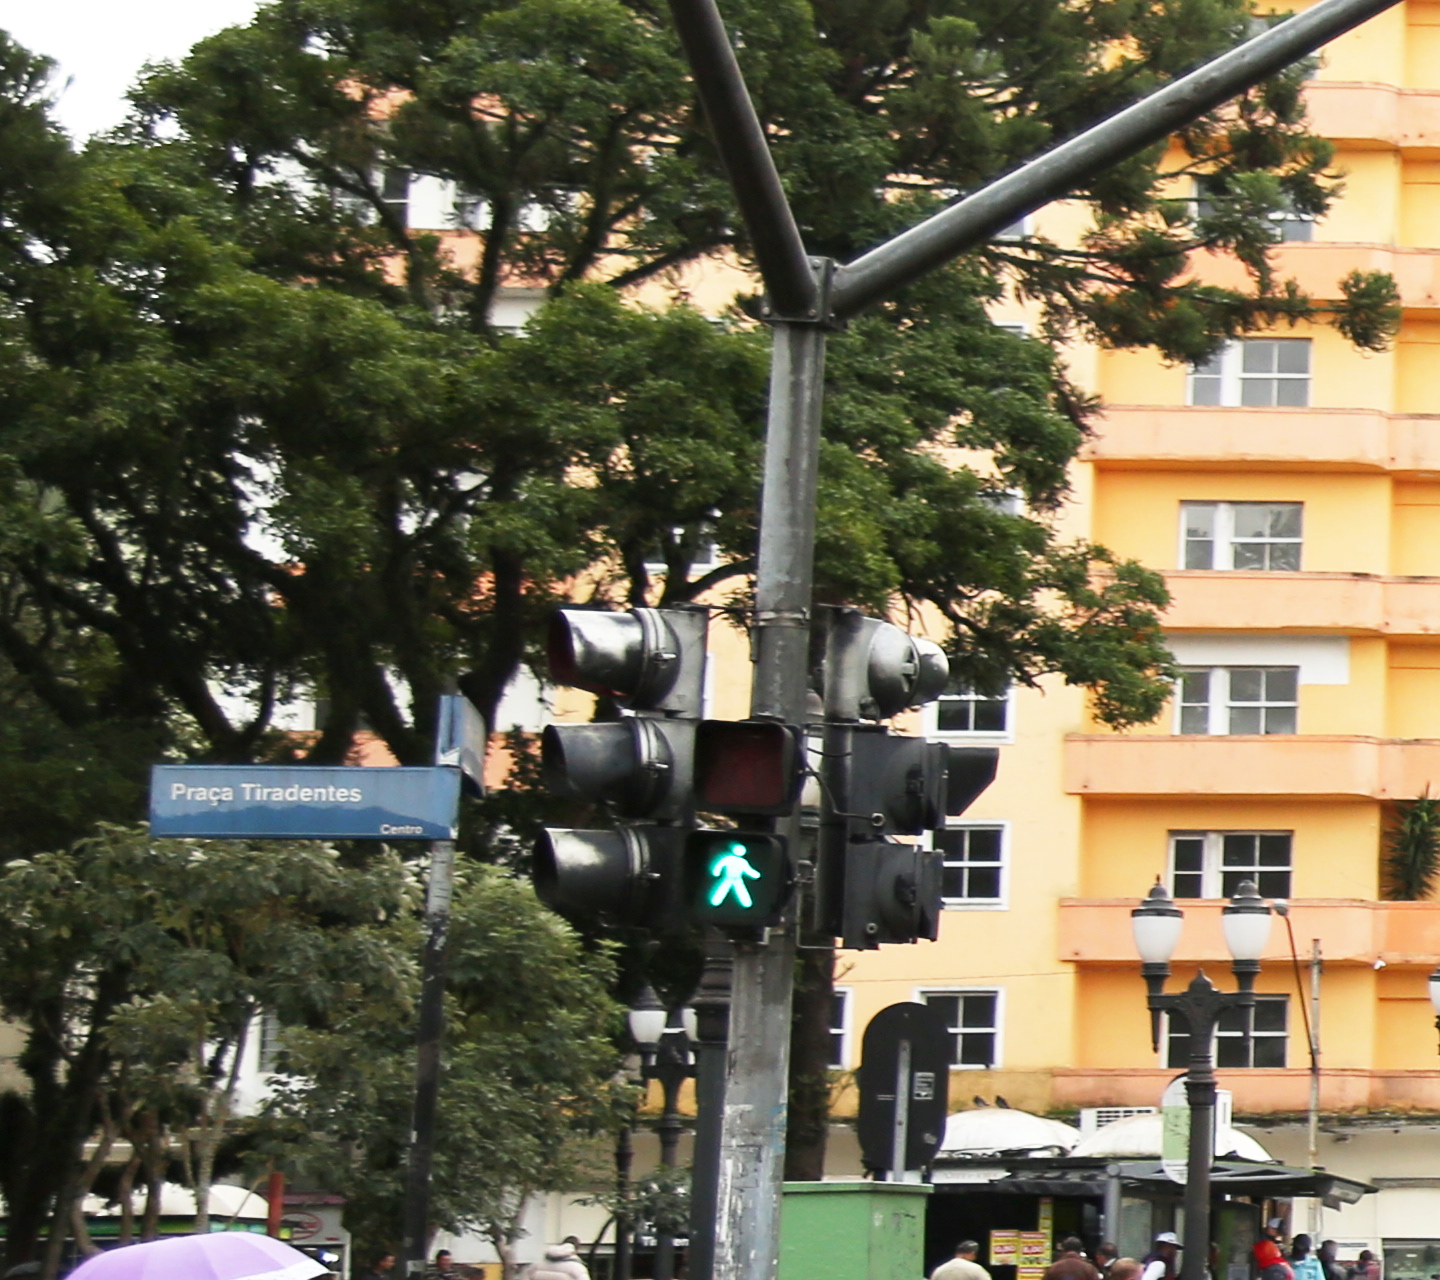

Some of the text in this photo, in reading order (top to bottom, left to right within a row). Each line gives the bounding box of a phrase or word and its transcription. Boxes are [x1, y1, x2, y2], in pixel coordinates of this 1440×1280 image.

[171, 783, 362, 806] Praça Tiradentes
[380, 823, 423, 834] Centro
